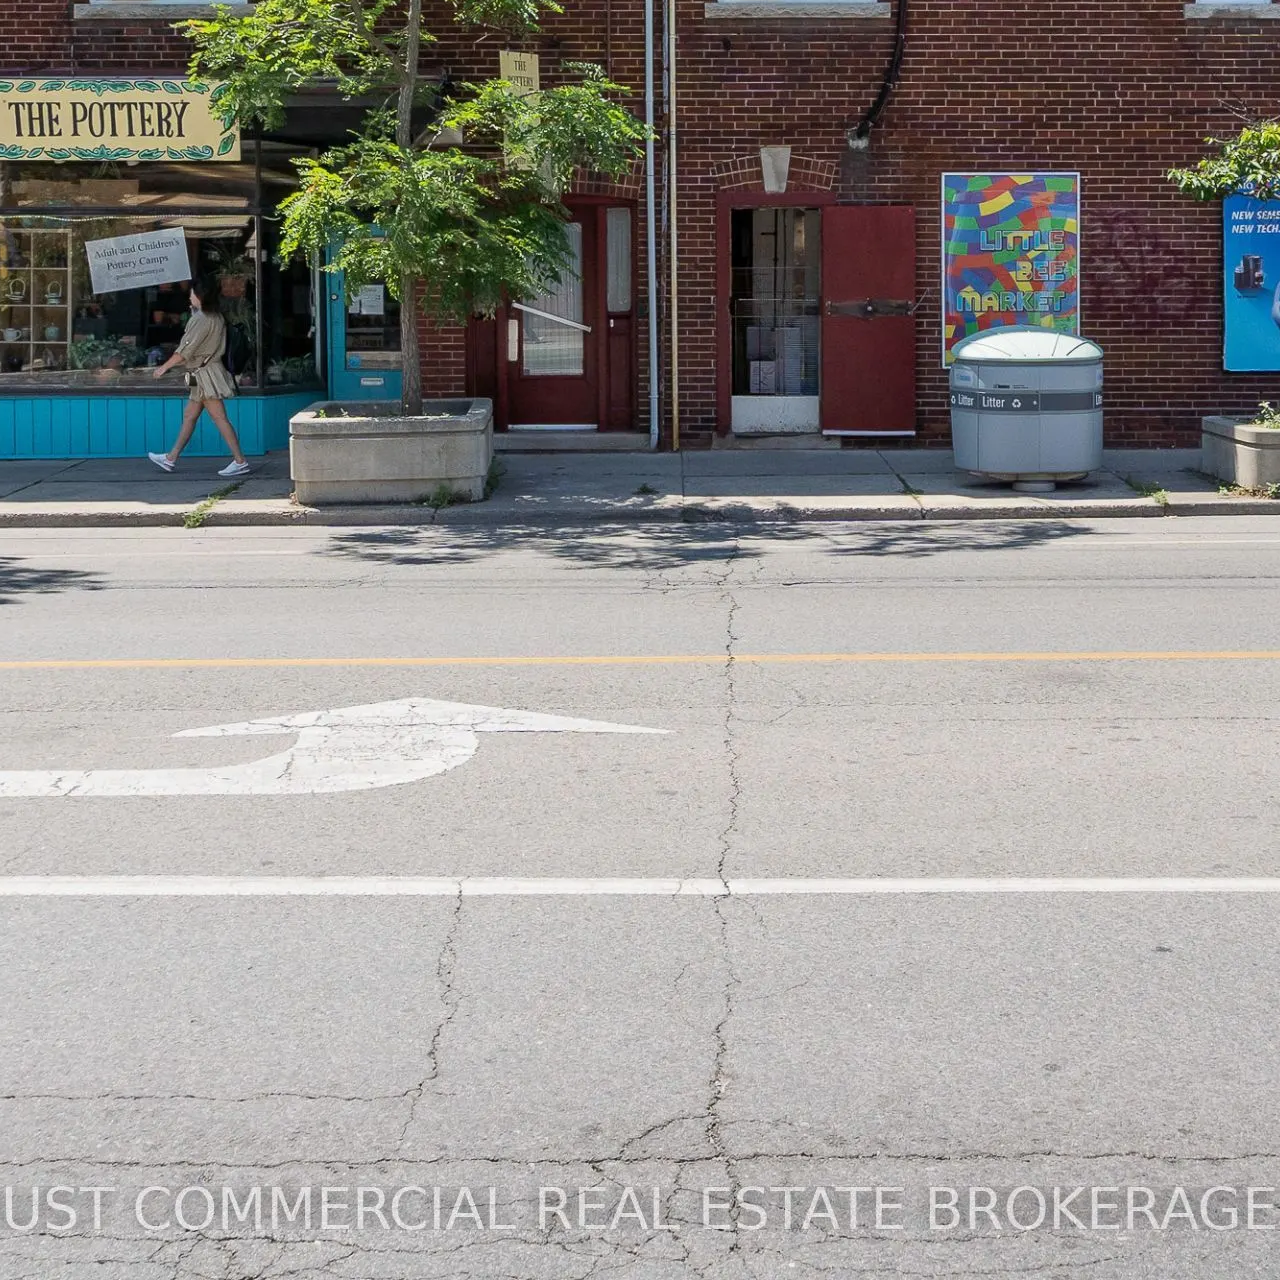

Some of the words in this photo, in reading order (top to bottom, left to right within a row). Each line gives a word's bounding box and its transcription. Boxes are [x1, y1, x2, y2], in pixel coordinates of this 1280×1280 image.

[8, 101, 62, 138] THE
[70, 100, 190, 138] POTTERY
[1231, 211, 1254, 220] NEW
[1231, 224, 1254, 233] NEW
[980, 230, 1065, 251] LITTLE
[95, 248, 118, 259] Adult
[120, 245, 136, 254] and
[107, 259, 137, 271] Pottery
[139, 255, 169, 265] Camps
[1016, 260, 1066, 281] BEE
[956, 291, 1066, 312] MARKET
[982, 395, 1005, 408] Litter
